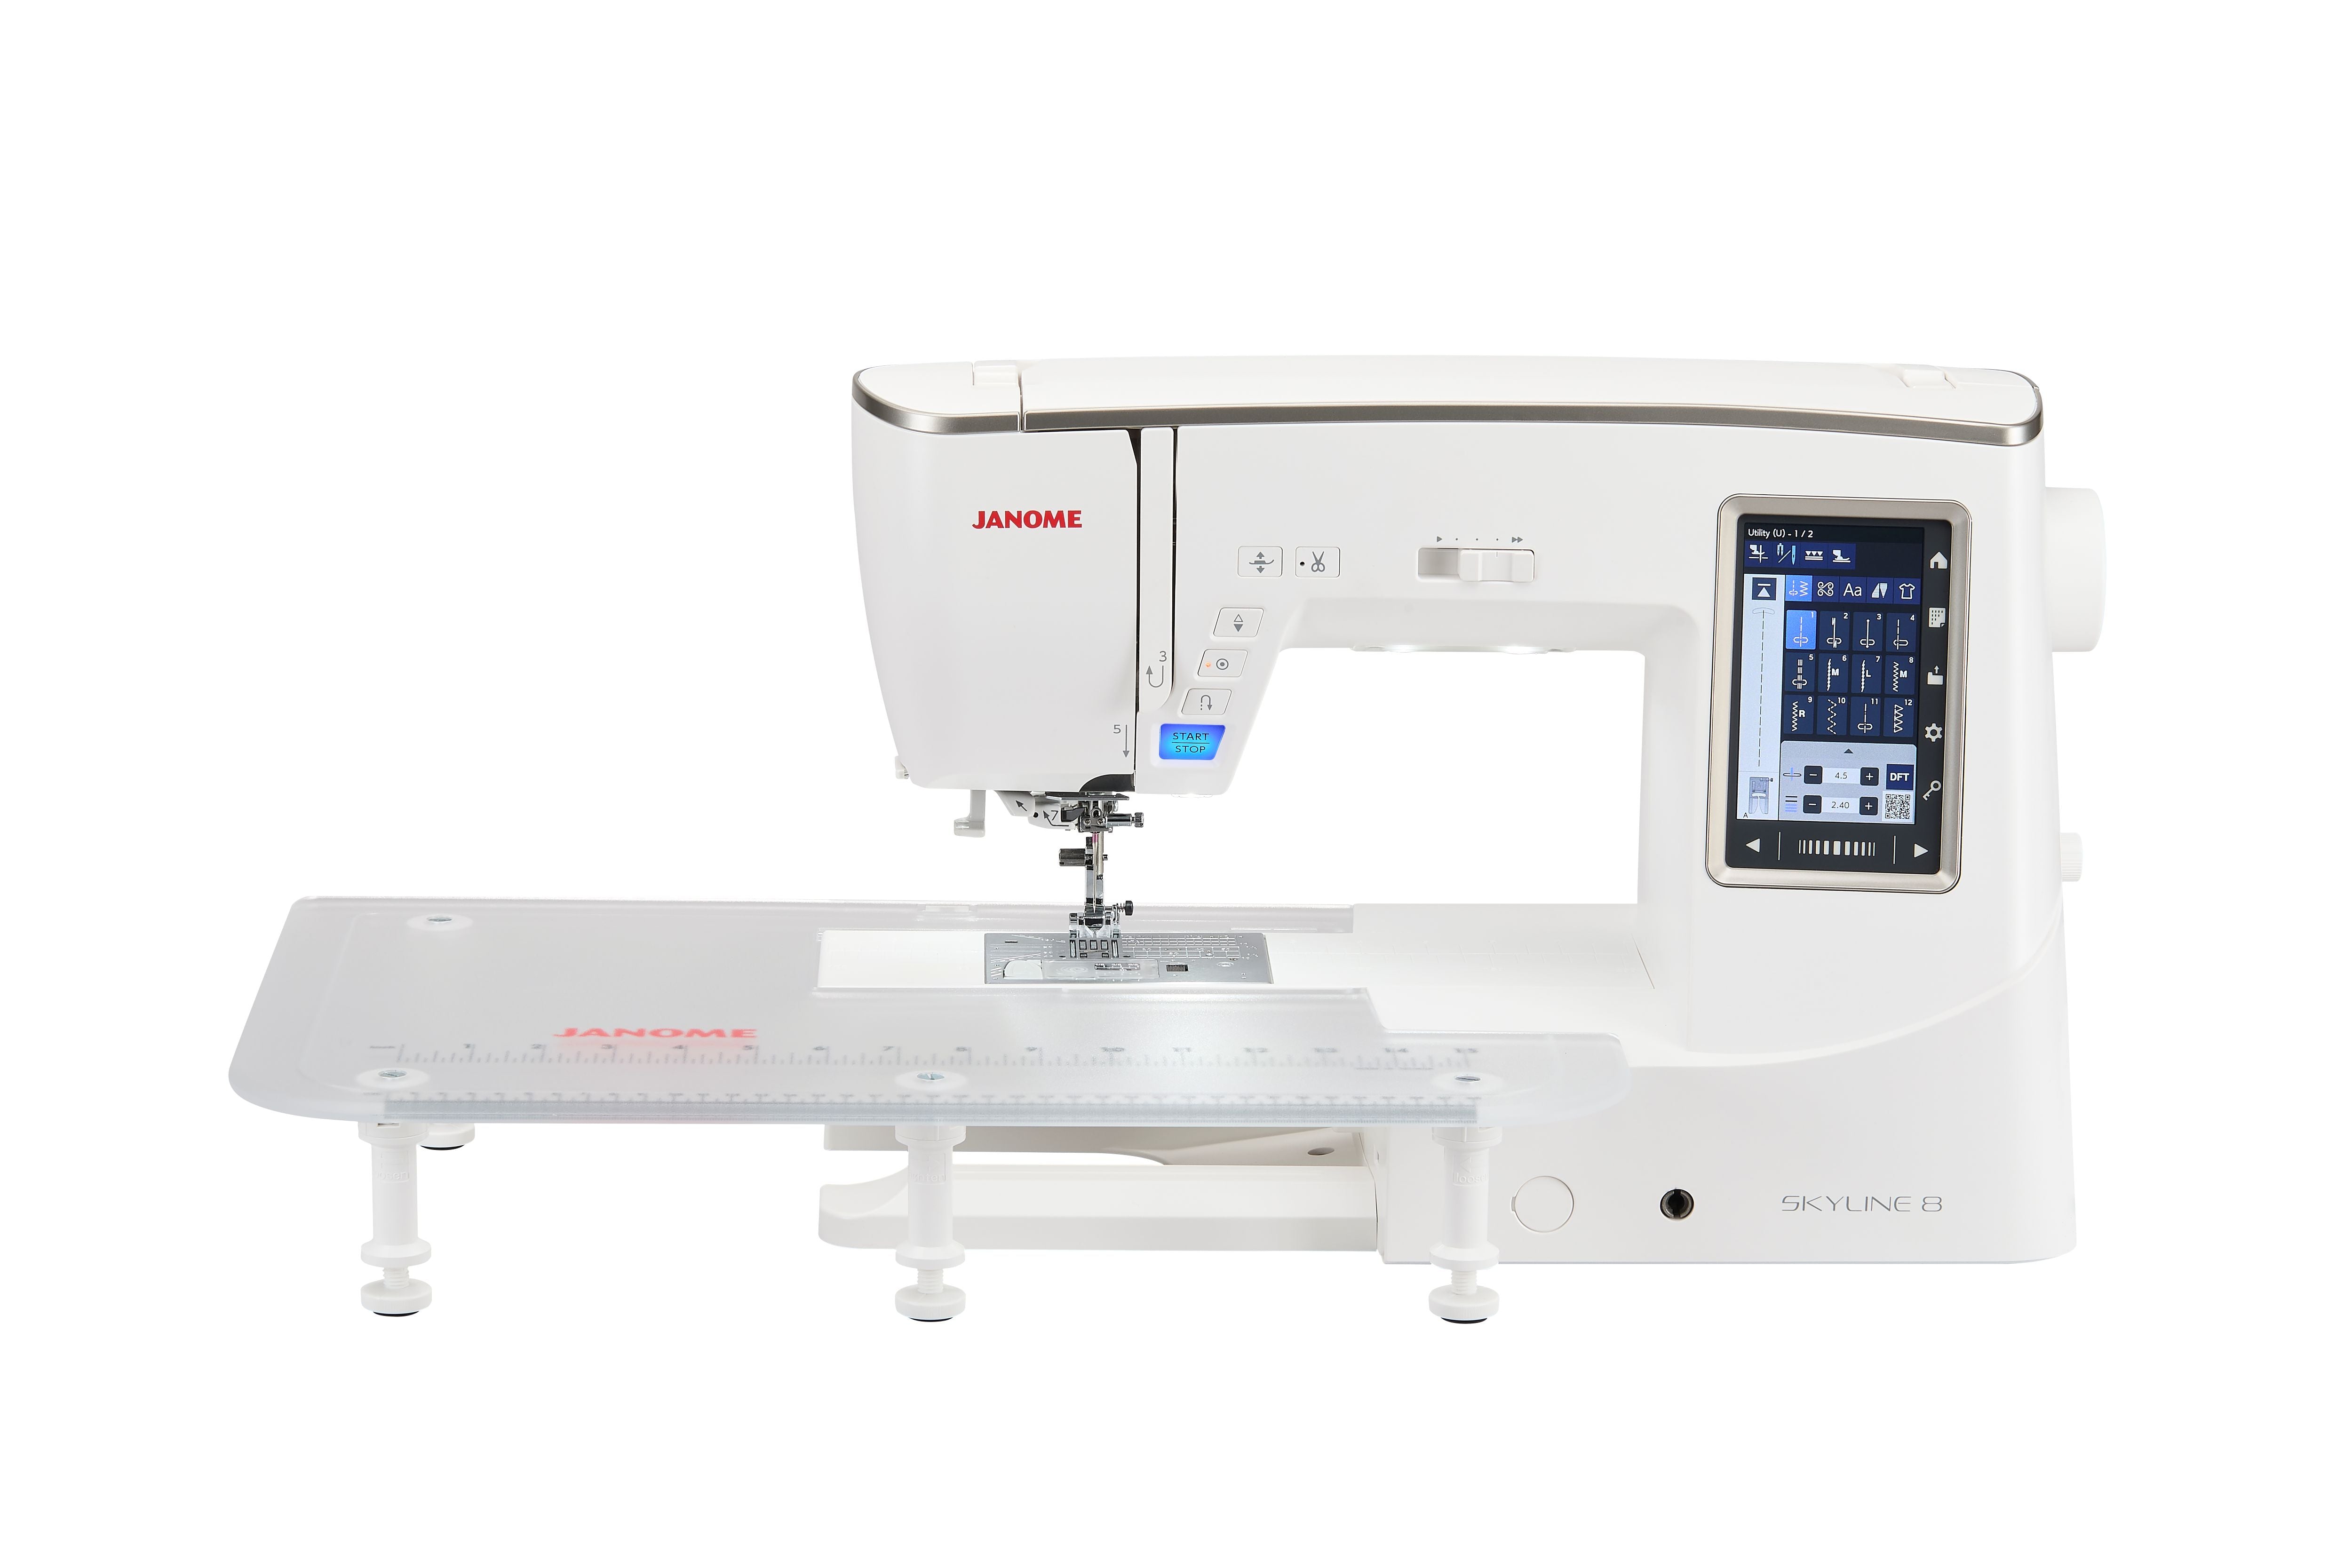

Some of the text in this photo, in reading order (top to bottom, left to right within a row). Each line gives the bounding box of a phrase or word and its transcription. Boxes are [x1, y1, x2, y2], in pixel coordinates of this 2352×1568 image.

[972, 510, 1082, 529] JANOME
[1748, 529, 1770, 539] Utility
[1773, 528, 1786, 539] (U)
[1843, 583, 1862, 596] Aa
[1159, 651, 1167, 662] 3
[1113, 724, 1121, 734] 5
[1890, 772, 1910, 781] DFT
[1051, 810, 1058, 821] 7
[554, 1028, 756, 1038] JANOME
[1782, 1196, 1942, 1212] SKYLINE 8
